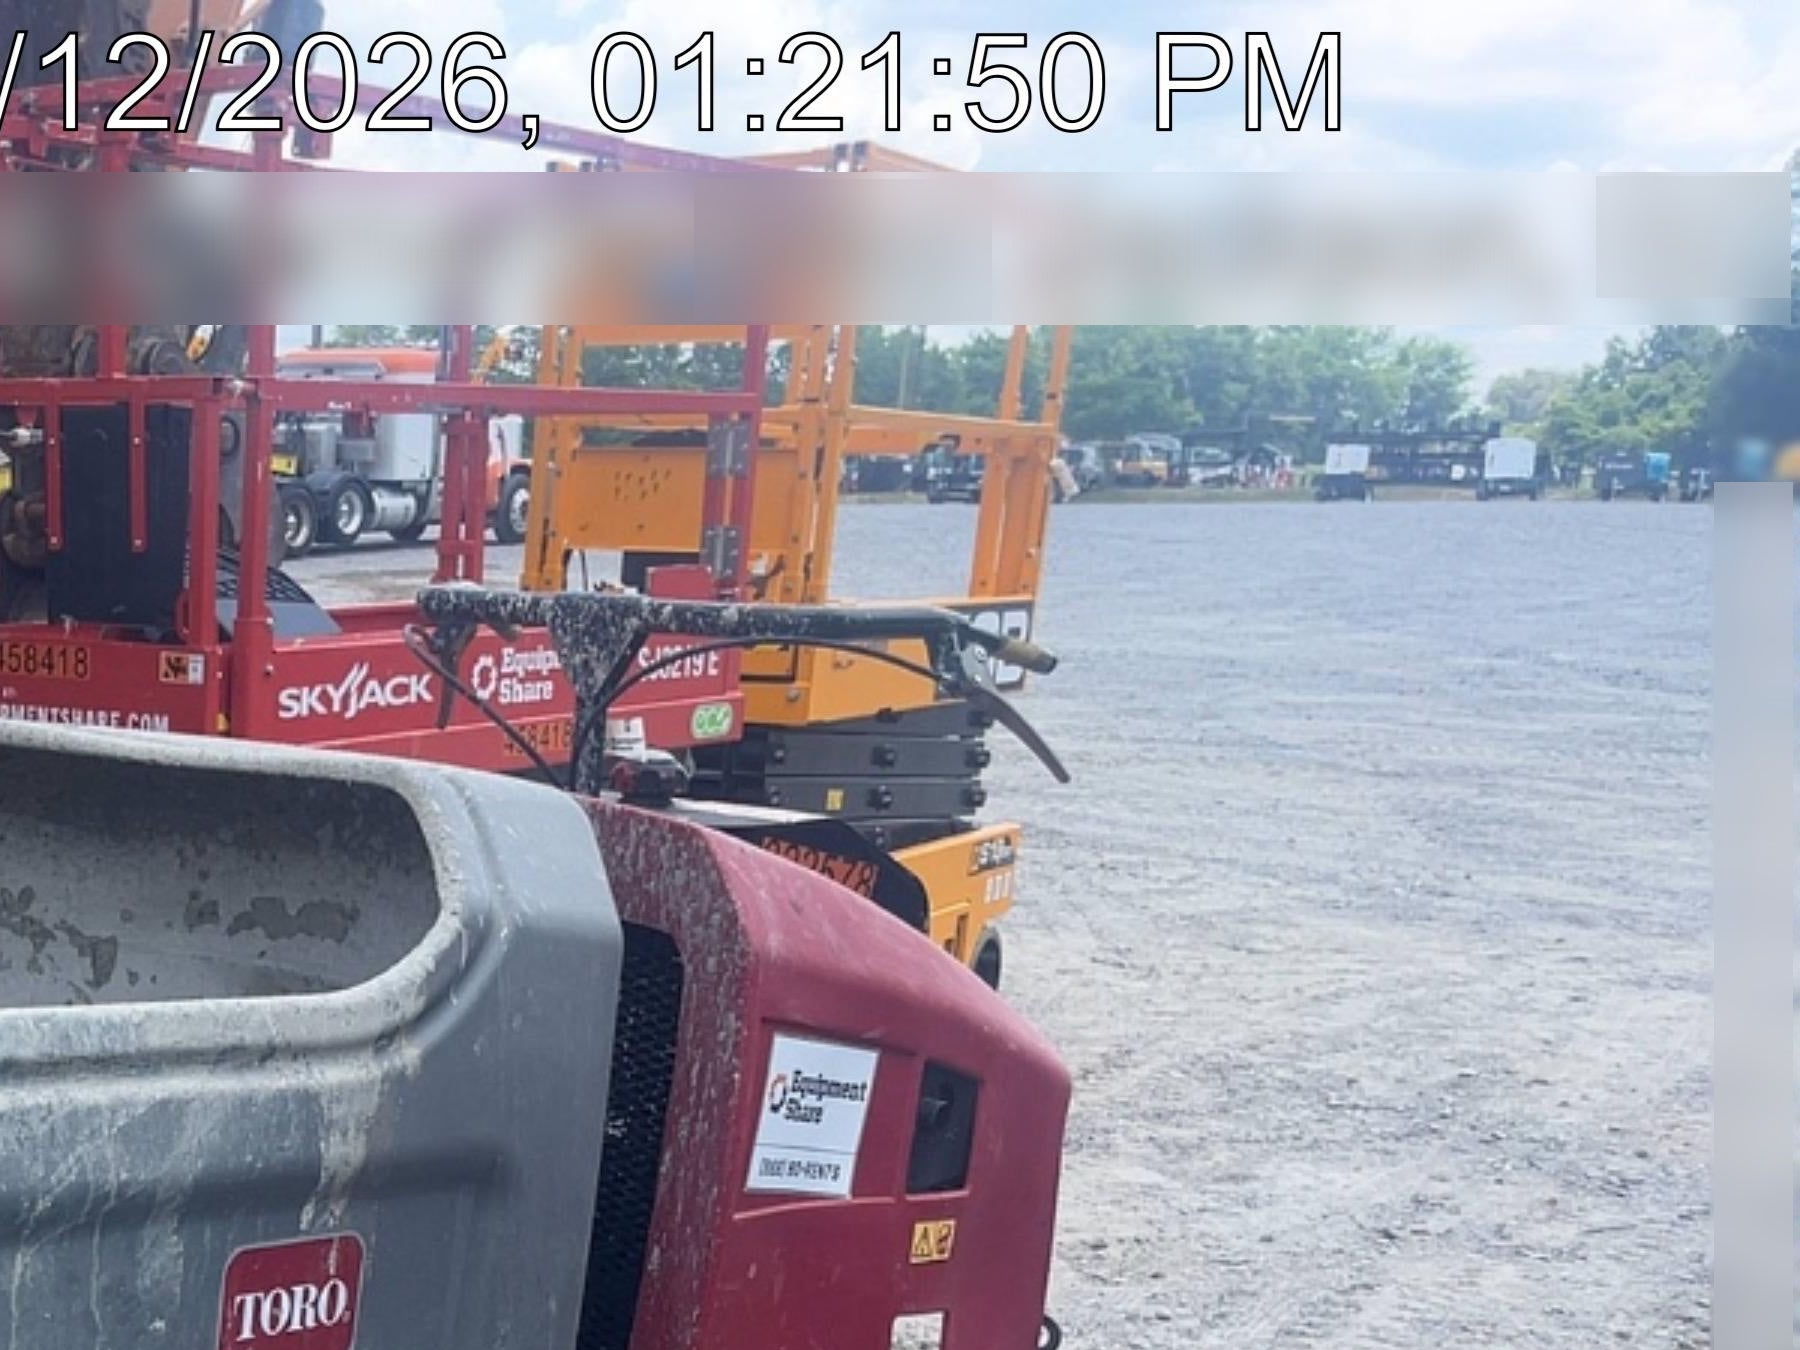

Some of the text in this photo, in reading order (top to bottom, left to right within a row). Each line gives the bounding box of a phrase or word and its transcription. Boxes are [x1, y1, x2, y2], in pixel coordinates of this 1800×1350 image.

[278, 662, 434, 720] SKYJACK
[499, 679, 553, 705] Share
[791, 1070, 867, 1101] Equipment
[234, 1278, 349, 1342] TORO
